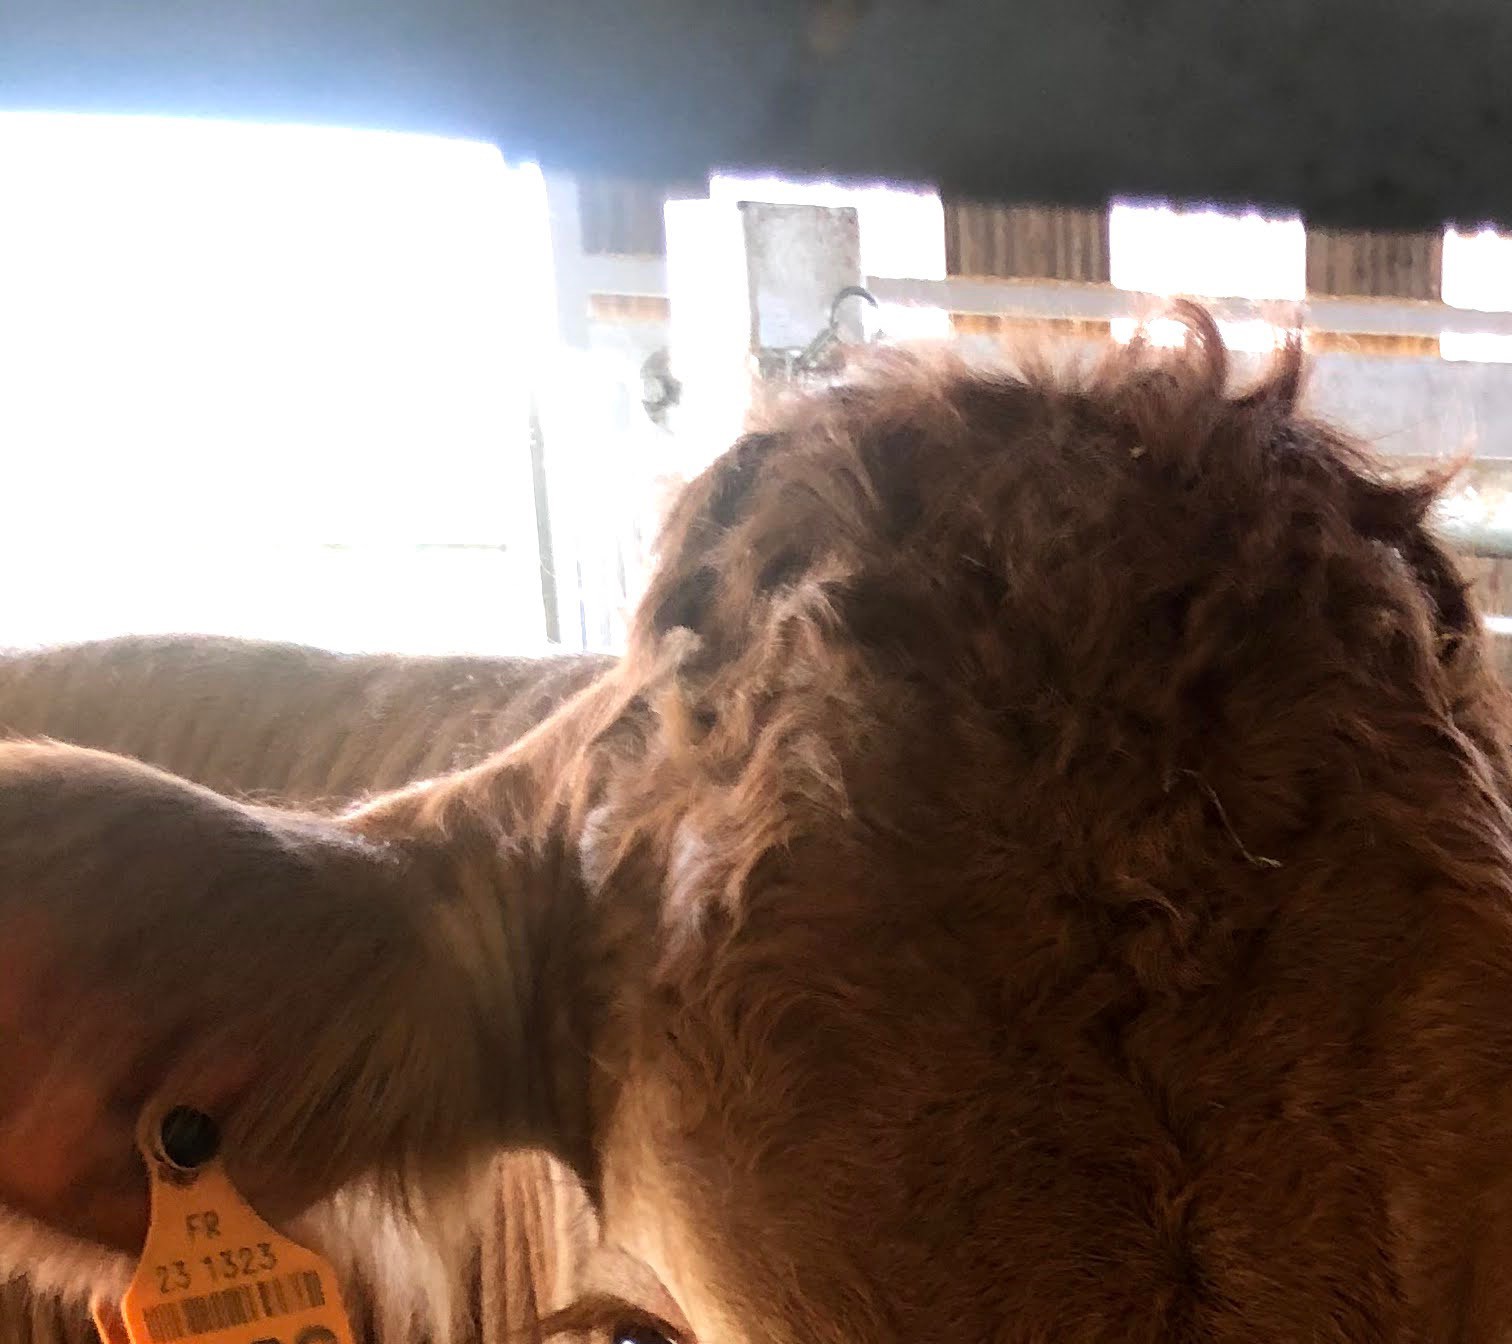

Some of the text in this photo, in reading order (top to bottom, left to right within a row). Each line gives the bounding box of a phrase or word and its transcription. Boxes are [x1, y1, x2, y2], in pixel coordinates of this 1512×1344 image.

[186, 1210, 221, 1241] FR
[156, 1242, 277, 1294] 23 1323
